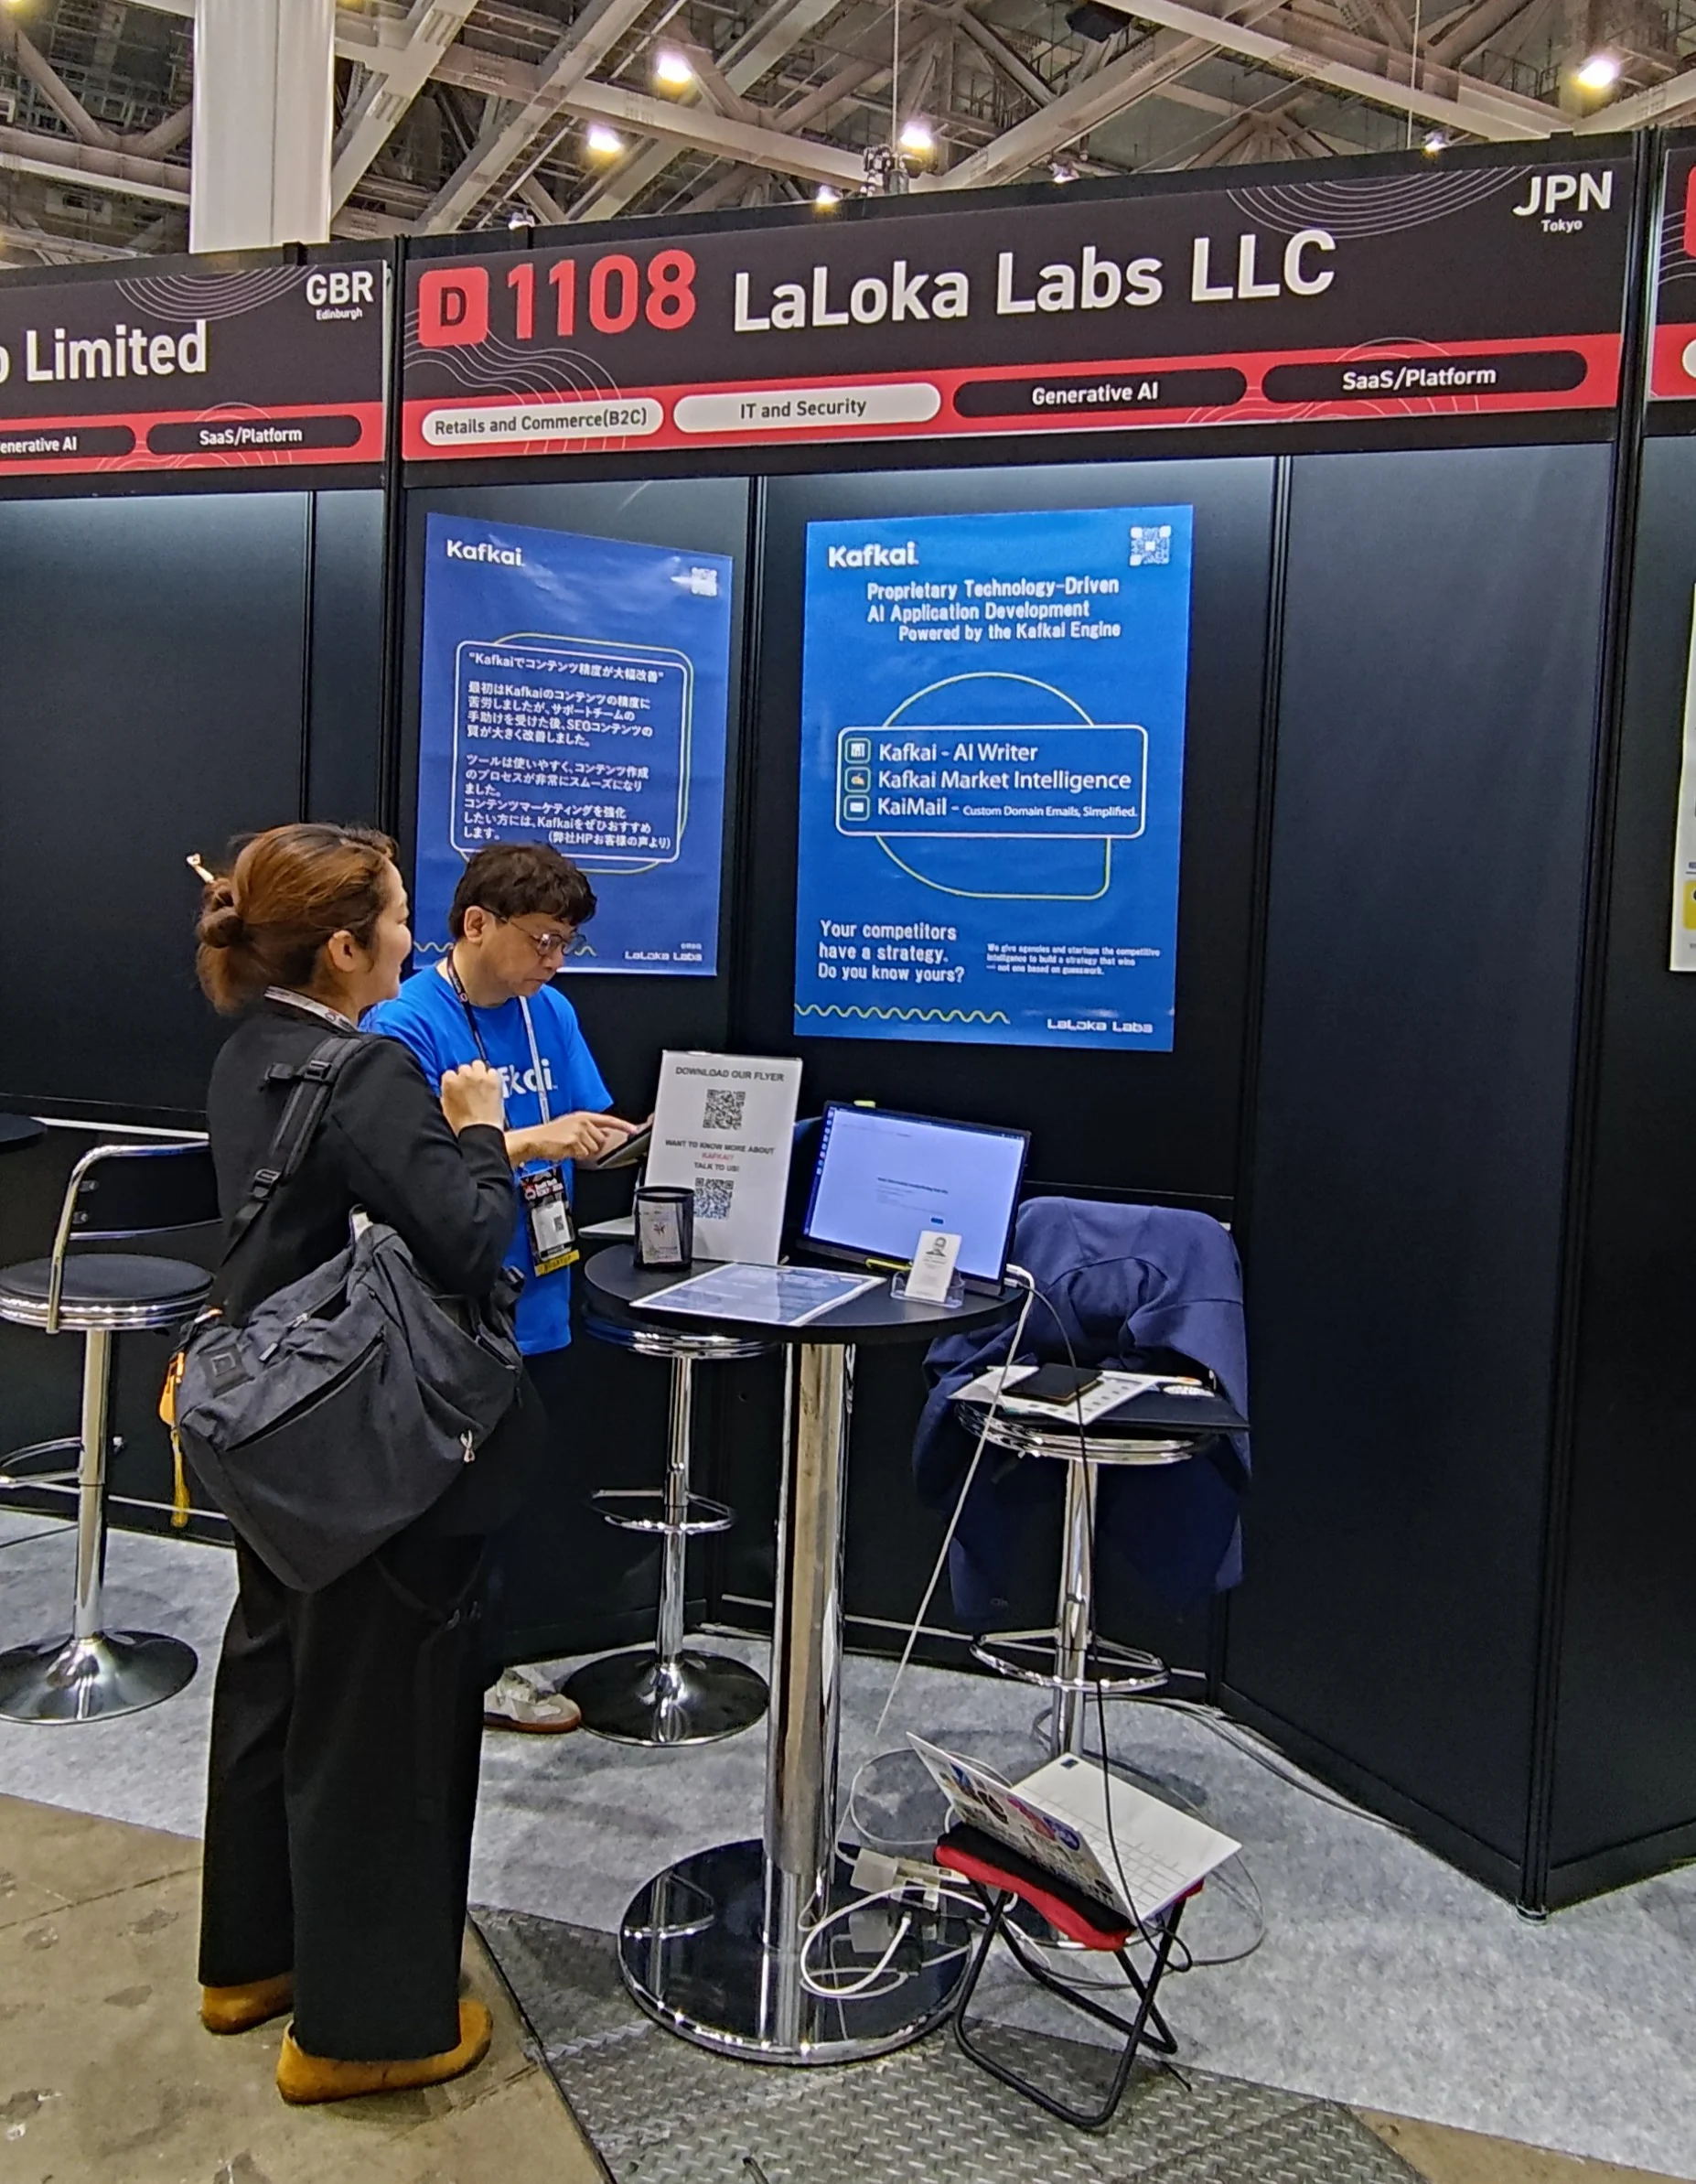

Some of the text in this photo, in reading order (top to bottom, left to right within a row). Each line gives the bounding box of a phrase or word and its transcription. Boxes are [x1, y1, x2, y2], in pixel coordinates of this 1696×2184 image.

[1512, 170, 1614, 217] JPN
[1540, 217, 1583, 233] Tokyo
[306, 272, 374, 306] GBR
[440, 229, 1336, 339] D 1108 LaLoka Labs LLC
[316, 308, 362, 321] Edinburgh
[26, 320, 207, 382] Limited
[1342, 365, 1497, 392] SaaS/Platform
[1032, 382, 1159, 406] Generative AI
[740, 397, 866, 419] IT and Security
[435, 407, 648, 436] Retails and Commerce(B2C)
[0, 436, 77, 454] enerative AI
[199, 428, 303, 445] SaaS/Platform
[445, 539, 523, 567] Kafkai
[867, 576, 1120, 601] Proprietary Technology-Driven
[867, 600, 1090, 624] AI Application Development
[898, 621, 1121, 642] Powered by the Kafkai Engine
[879, 743, 937, 762] Kafkai
[953, 744, 974, 761] AI
[978, 744, 1038, 762] Writer
[878, 770, 1132, 794] Kafkai Market Intelligence
[877, 798, 947, 816] KaiMail
[963, 805, 1002, 816] Custom
[1004, 805, 1044, 816] Domain
[1046, 806, 1080, 818] Emails,
[1082, 806, 1138, 819] Simplified.
[821, 920, 957, 943] Your competitors
[819, 941, 949, 965] have a strategy.
[818, 964, 965, 984] Do you know yours?
[1047, 1018, 1153, 1033] LaLoka Labs
[675, 1066, 784, 1081] DOWNLOAD OUR FLYER
[665, 1139, 775, 1155] WANT TO KNOW MORE ABOUT
[693, 1162, 713, 1170] TALK
